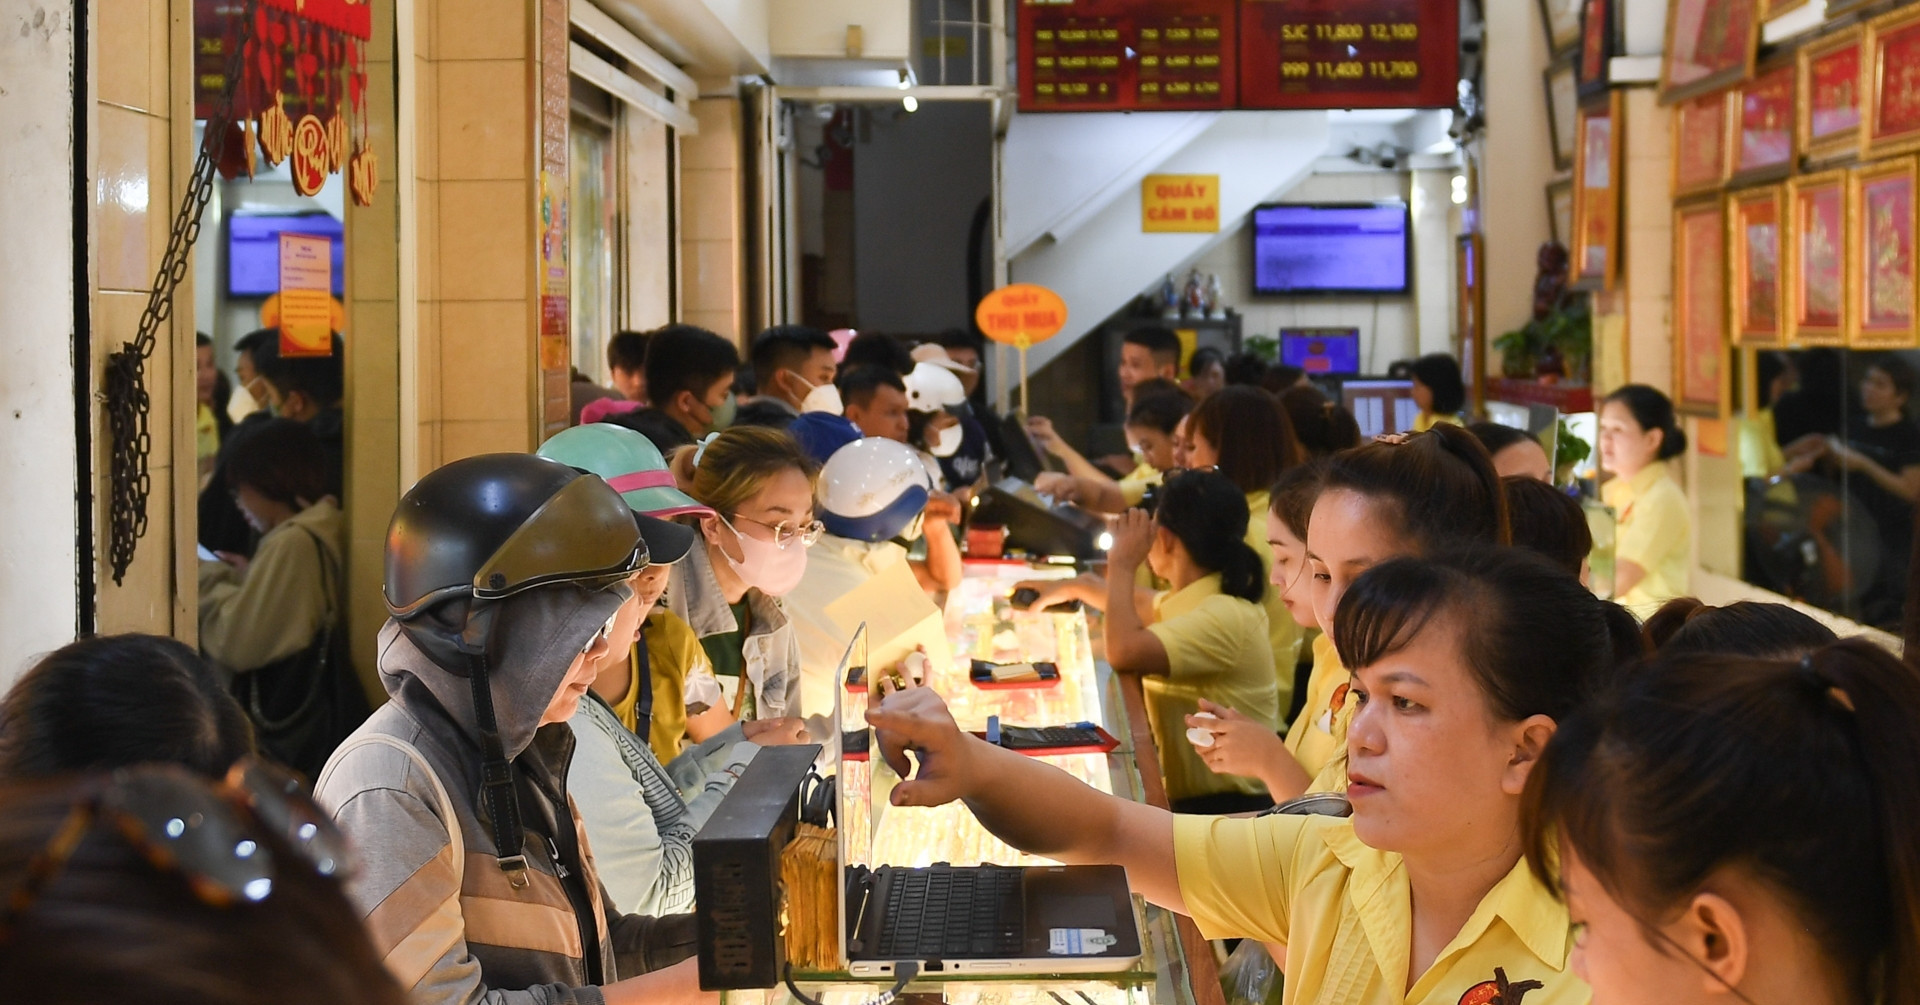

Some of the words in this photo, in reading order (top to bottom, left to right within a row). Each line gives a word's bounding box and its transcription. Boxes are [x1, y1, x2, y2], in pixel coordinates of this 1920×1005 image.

[1281, 24, 1308, 39] SJC
[1315, 23, 1364, 41] 11,800
[1369, 23, 1418, 41] 12,100
[1281, 61, 1310, 76] 999
[1315, 61, 1364, 80] 11,400
[1369, 61, 1418, 79] 11,700
[986, 313, 1019, 331] THU
[1024, 309, 1059, 329] MUA
